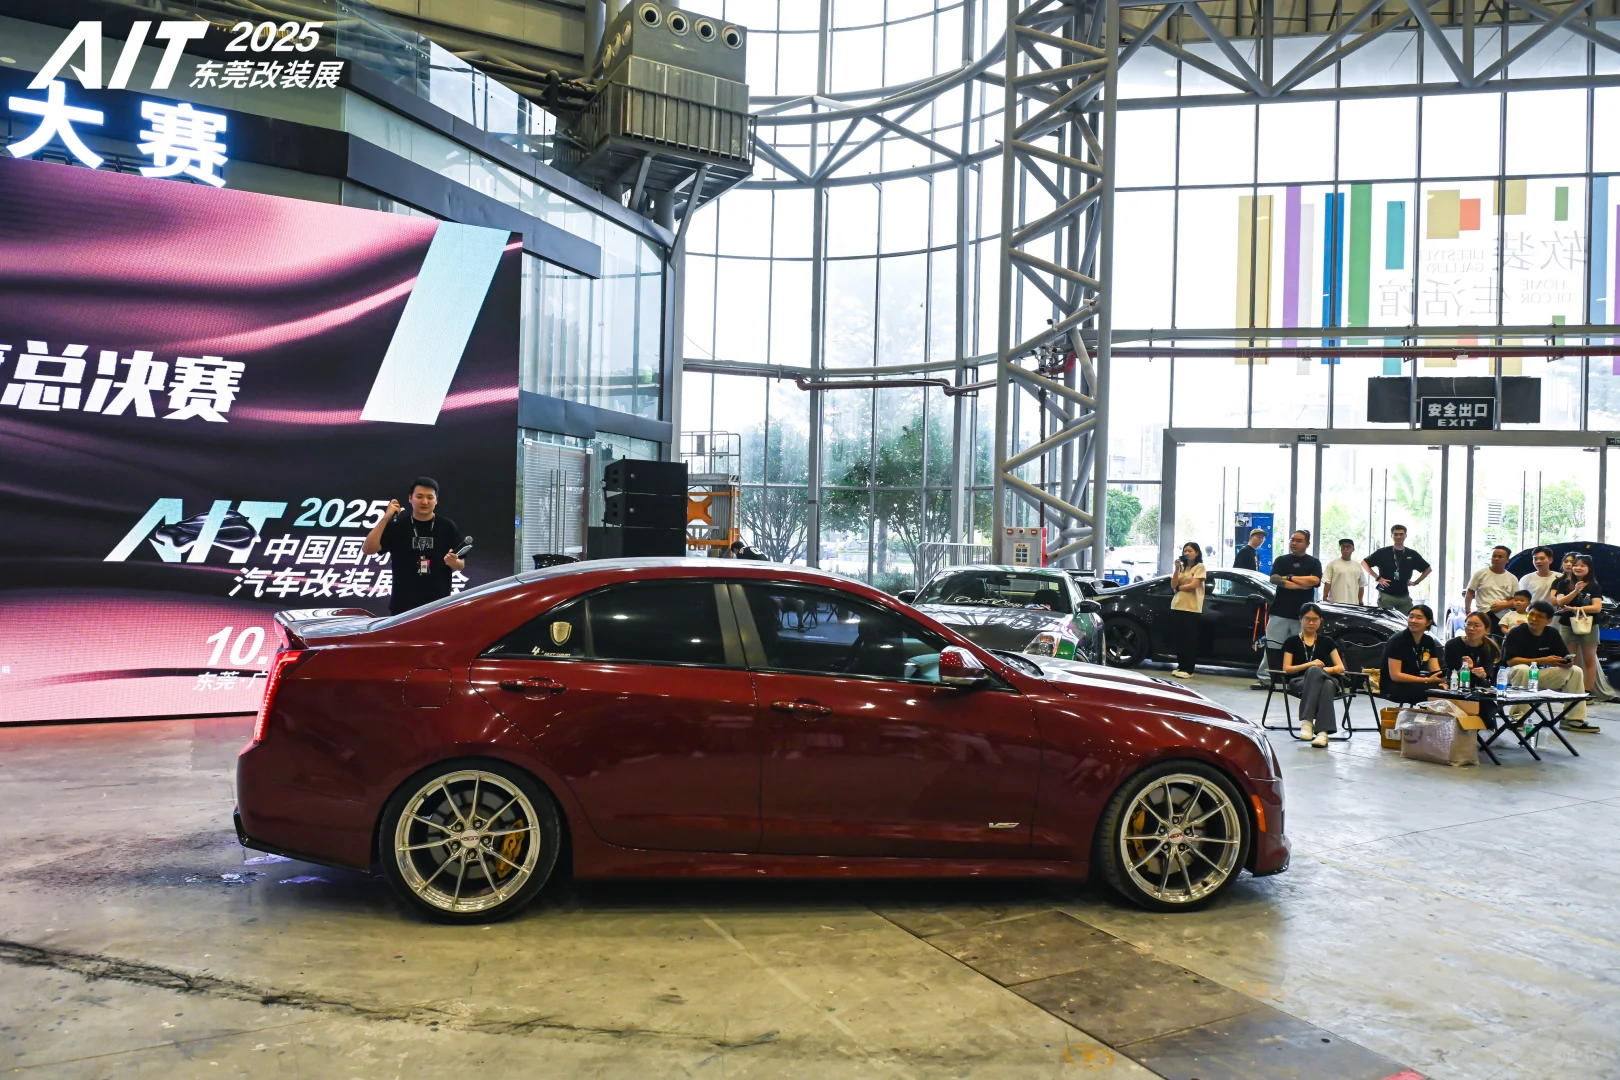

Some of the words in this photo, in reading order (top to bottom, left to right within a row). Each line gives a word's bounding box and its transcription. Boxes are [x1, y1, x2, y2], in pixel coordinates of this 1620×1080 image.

[6, 79, 229, 189] 大赛
[0, 340, 246, 423] 总决赛
[1427, 402, 1488, 418] 安全出口
[1437, 418, 1477, 427] EXIT
[293, 497, 391, 529] 2025
